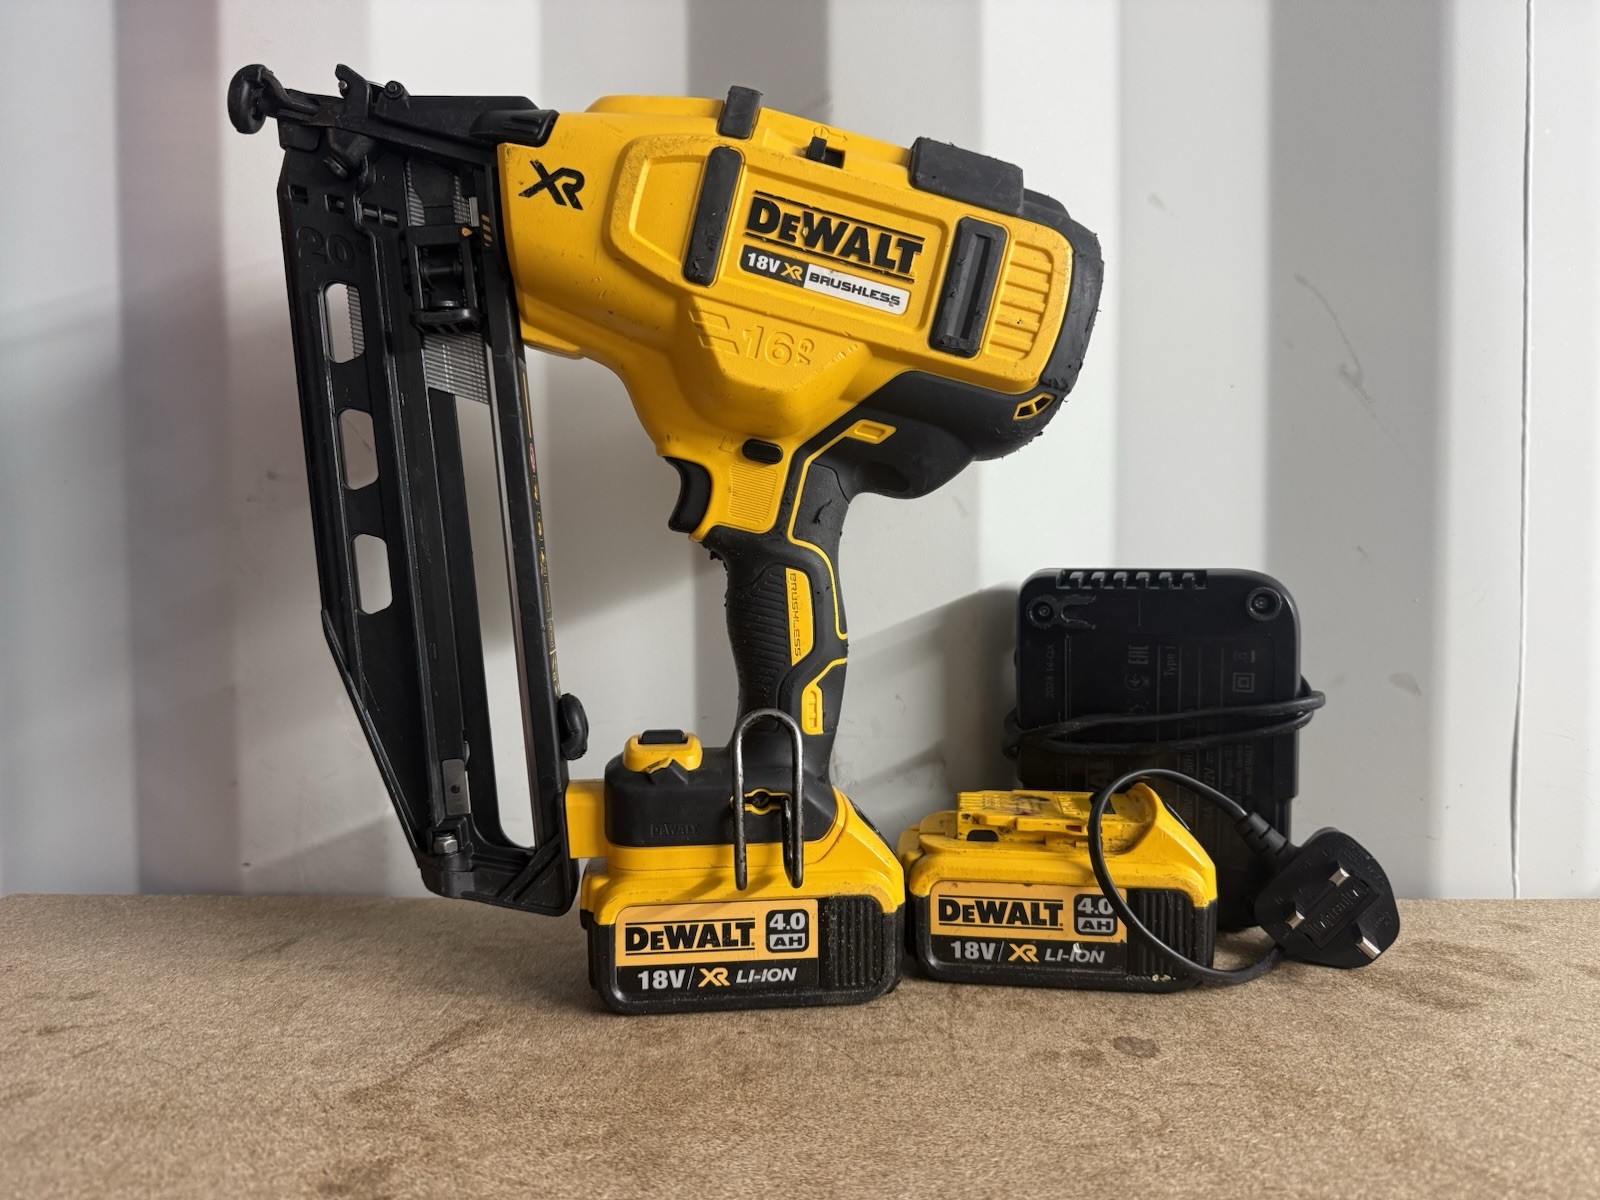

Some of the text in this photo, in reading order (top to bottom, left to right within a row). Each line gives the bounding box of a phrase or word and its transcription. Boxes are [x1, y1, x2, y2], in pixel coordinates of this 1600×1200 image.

[518, 159, 585, 211] XR
[746, 195, 924, 275] DEWALT
[747, 252, 901, 307] 18V XR BRUSHLESS
[742, 325, 795, 367] 16
[789, 572, 802, 657] BRUSHLESS
[1163, 653, 1178, 677] Type
[1077, 897, 1114, 915] 4.0
[769, 912, 806, 931] 4.0
[1081, 919, 1112, 931] AH
[772, 936, 803, 947] AH
[1007, 943, 1040, 963] XR
[1044, 948, 1106, 964] LI-ION
[698, 967, 731, 987] XR
[736, 967, 797, 984] LI-ION
